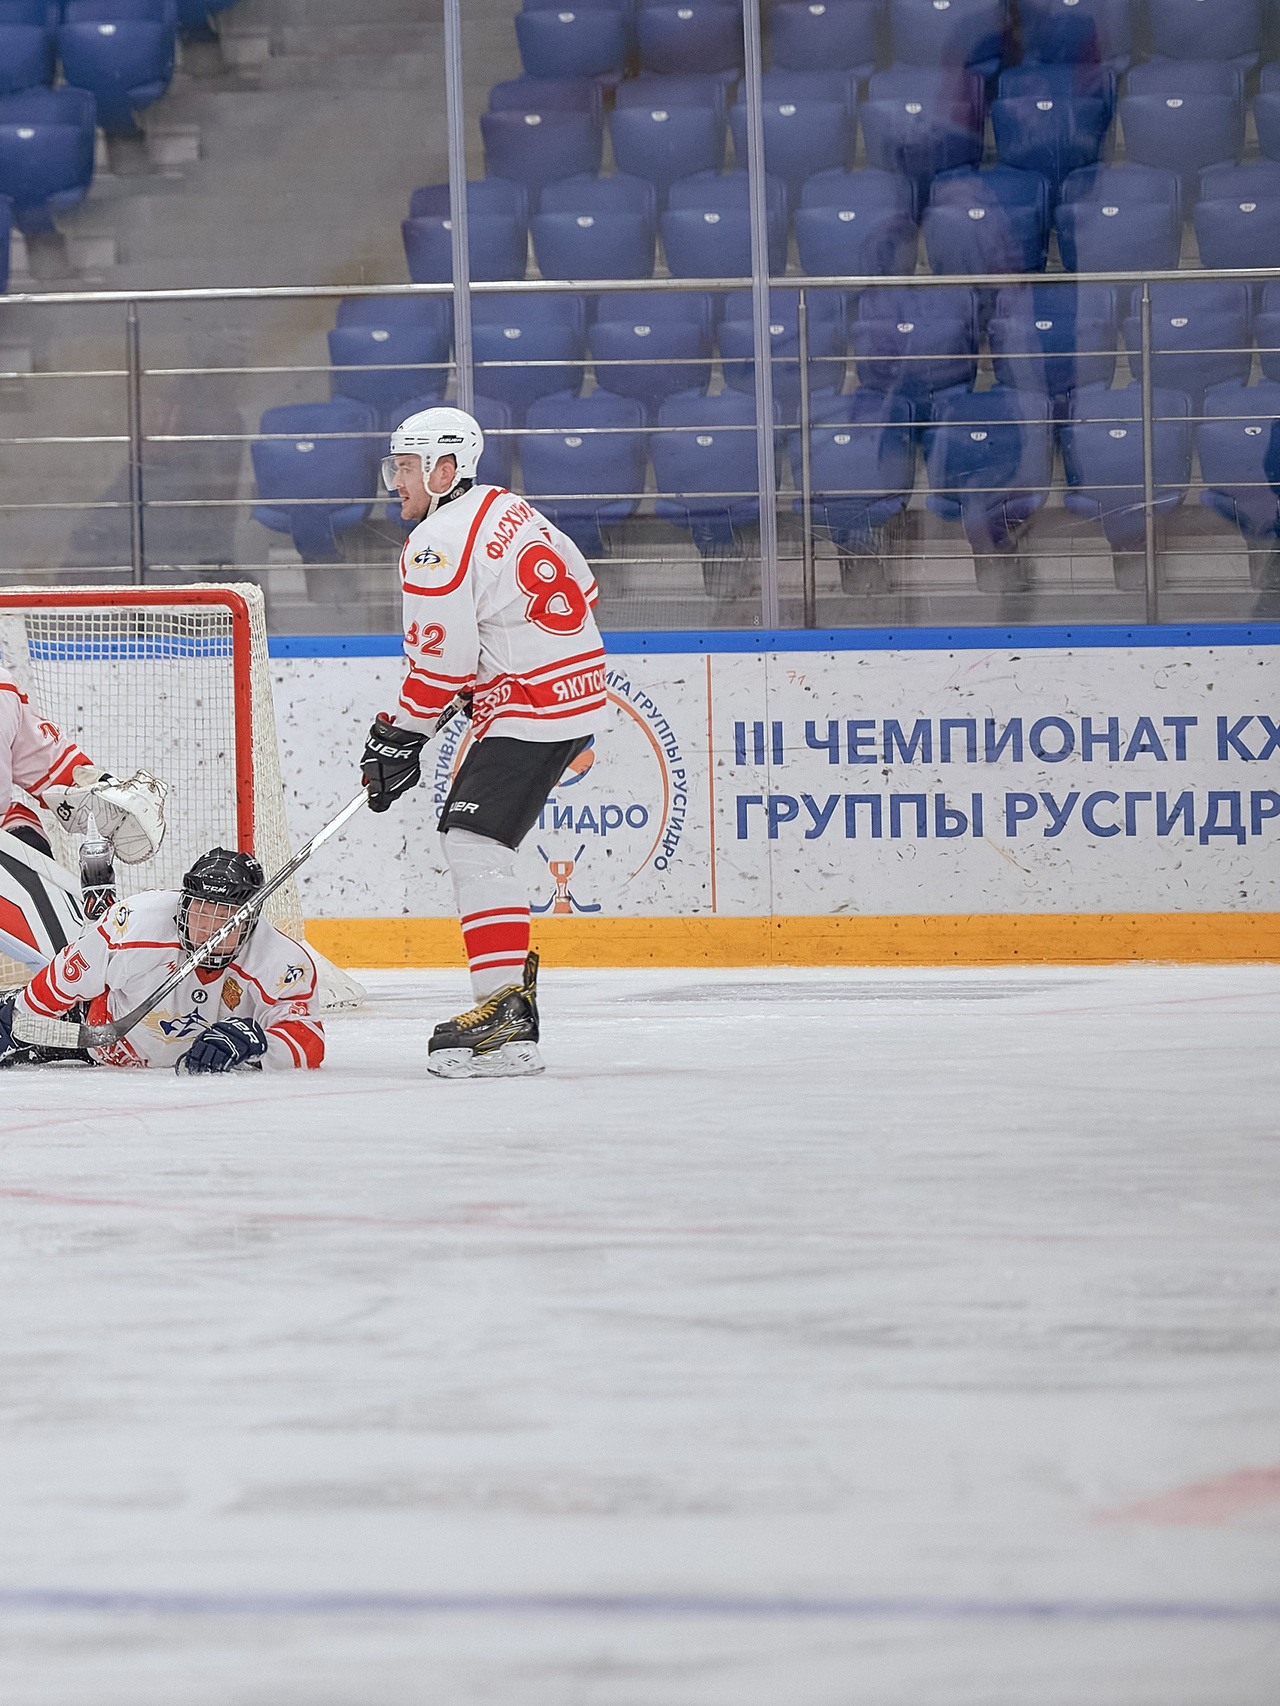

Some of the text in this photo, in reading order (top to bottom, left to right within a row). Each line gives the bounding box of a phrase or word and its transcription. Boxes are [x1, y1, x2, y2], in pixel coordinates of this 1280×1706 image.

[516, 530, 589, 636] 8
[633, 690, 683, 764] ГРУППЫ
[804, 715, 1198, 766] ЧЕМПИОНАТ
[653, 768, 688, 871] РУСГИДРО
[735, 791, 983, 840] ГРУППЫ
